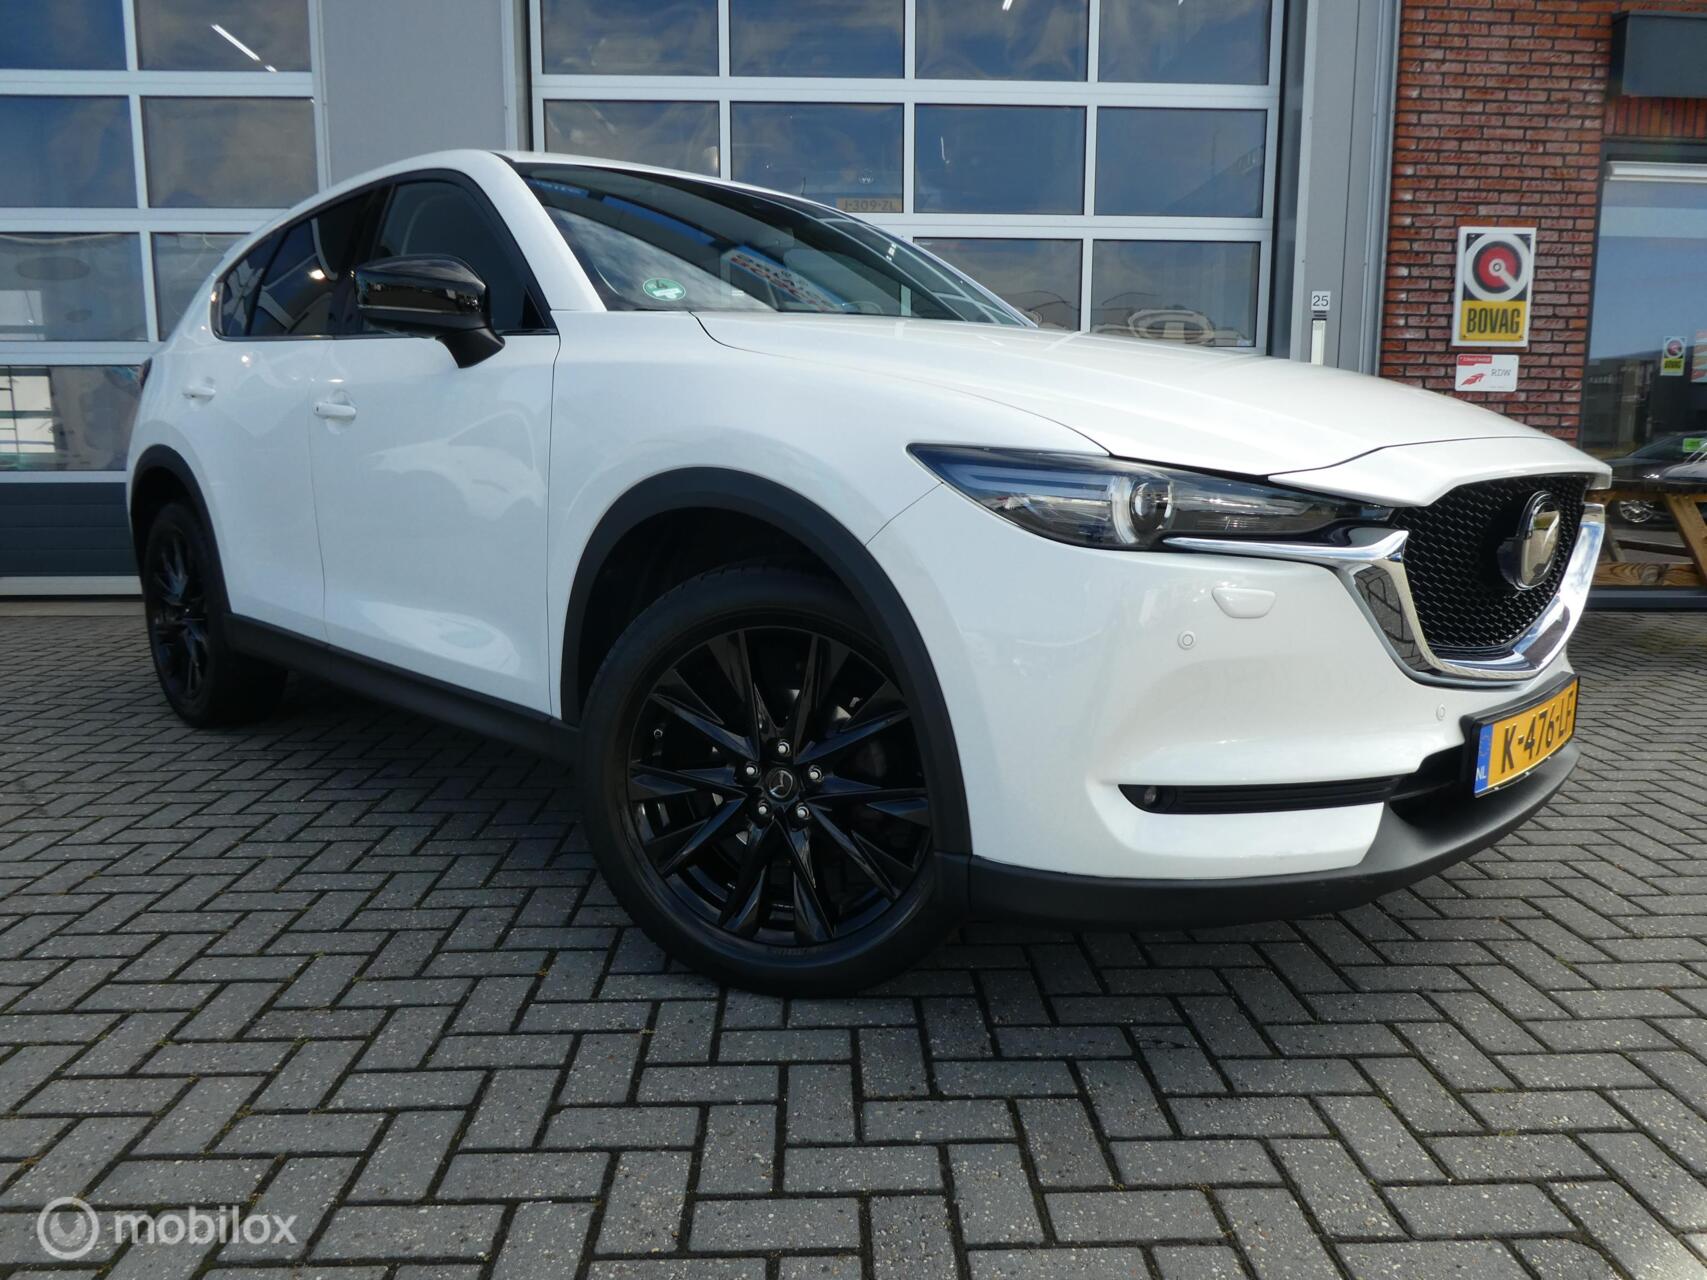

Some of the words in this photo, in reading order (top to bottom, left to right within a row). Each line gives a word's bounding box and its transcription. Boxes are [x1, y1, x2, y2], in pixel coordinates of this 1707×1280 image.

[1312, 295, 1329, 307] 25
[1466, 307, 1521, 334] BOVAG
[1475, 767, 1487, 782] NL
